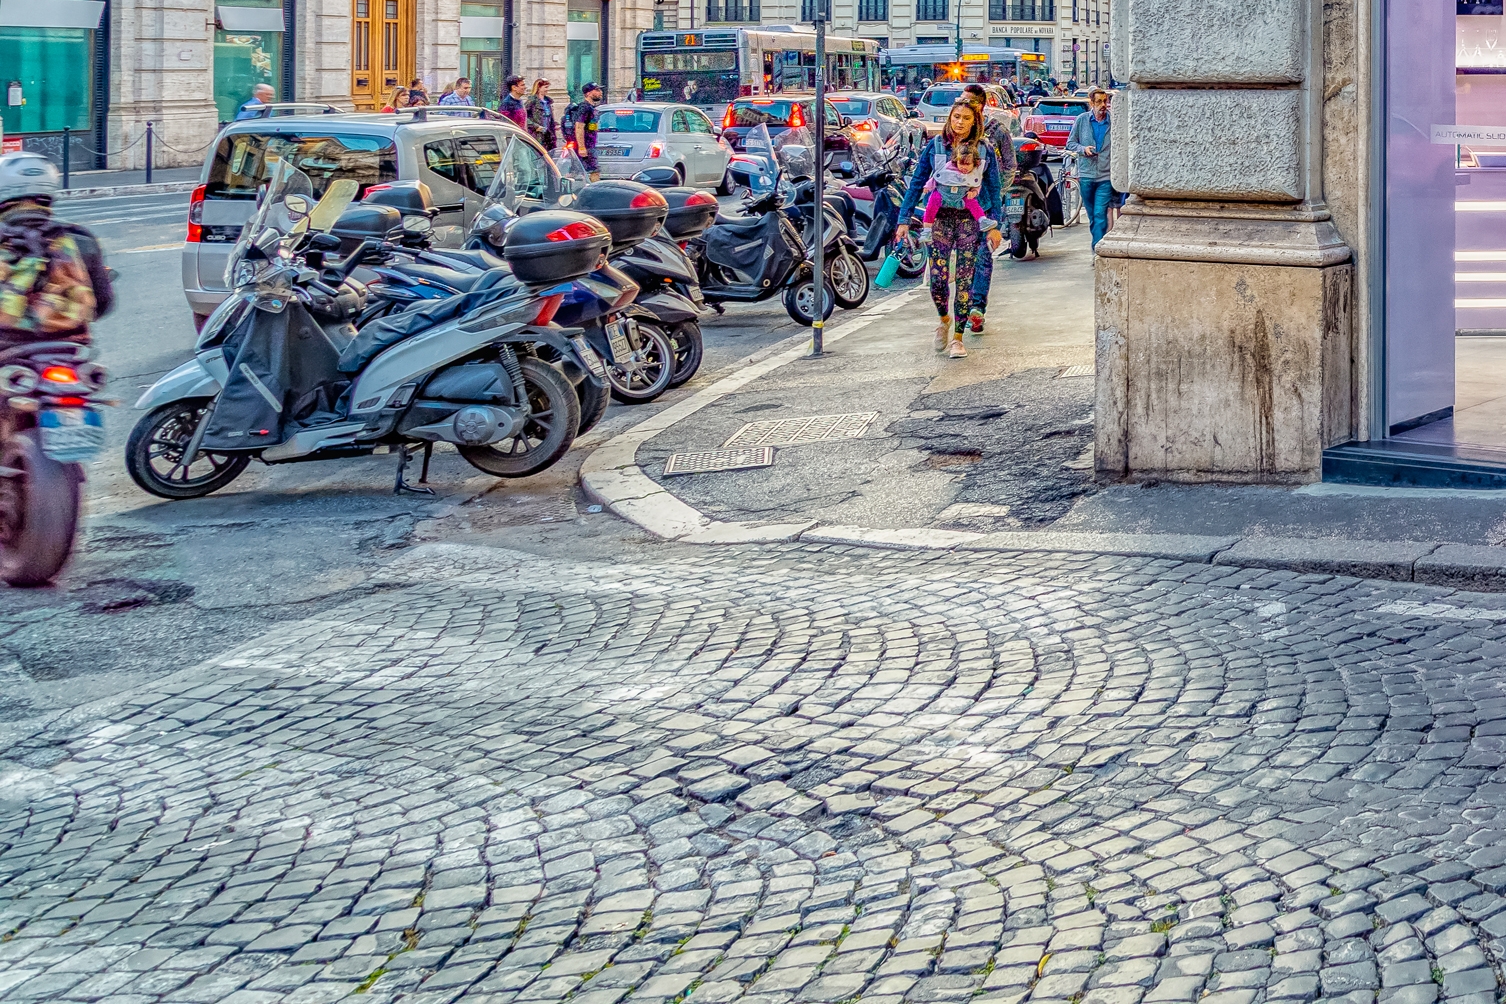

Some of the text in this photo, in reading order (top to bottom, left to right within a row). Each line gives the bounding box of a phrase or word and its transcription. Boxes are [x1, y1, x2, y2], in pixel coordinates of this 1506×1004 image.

[992, 26, 1008, 34] BANCA
[1010, 26, 1034, 34] POPOLARE
[1039, 27, 1054, 35] NOVARA
[684, 34, 696, 46] 71
[1435, 130, 1485, 140] AUTOMATIC
